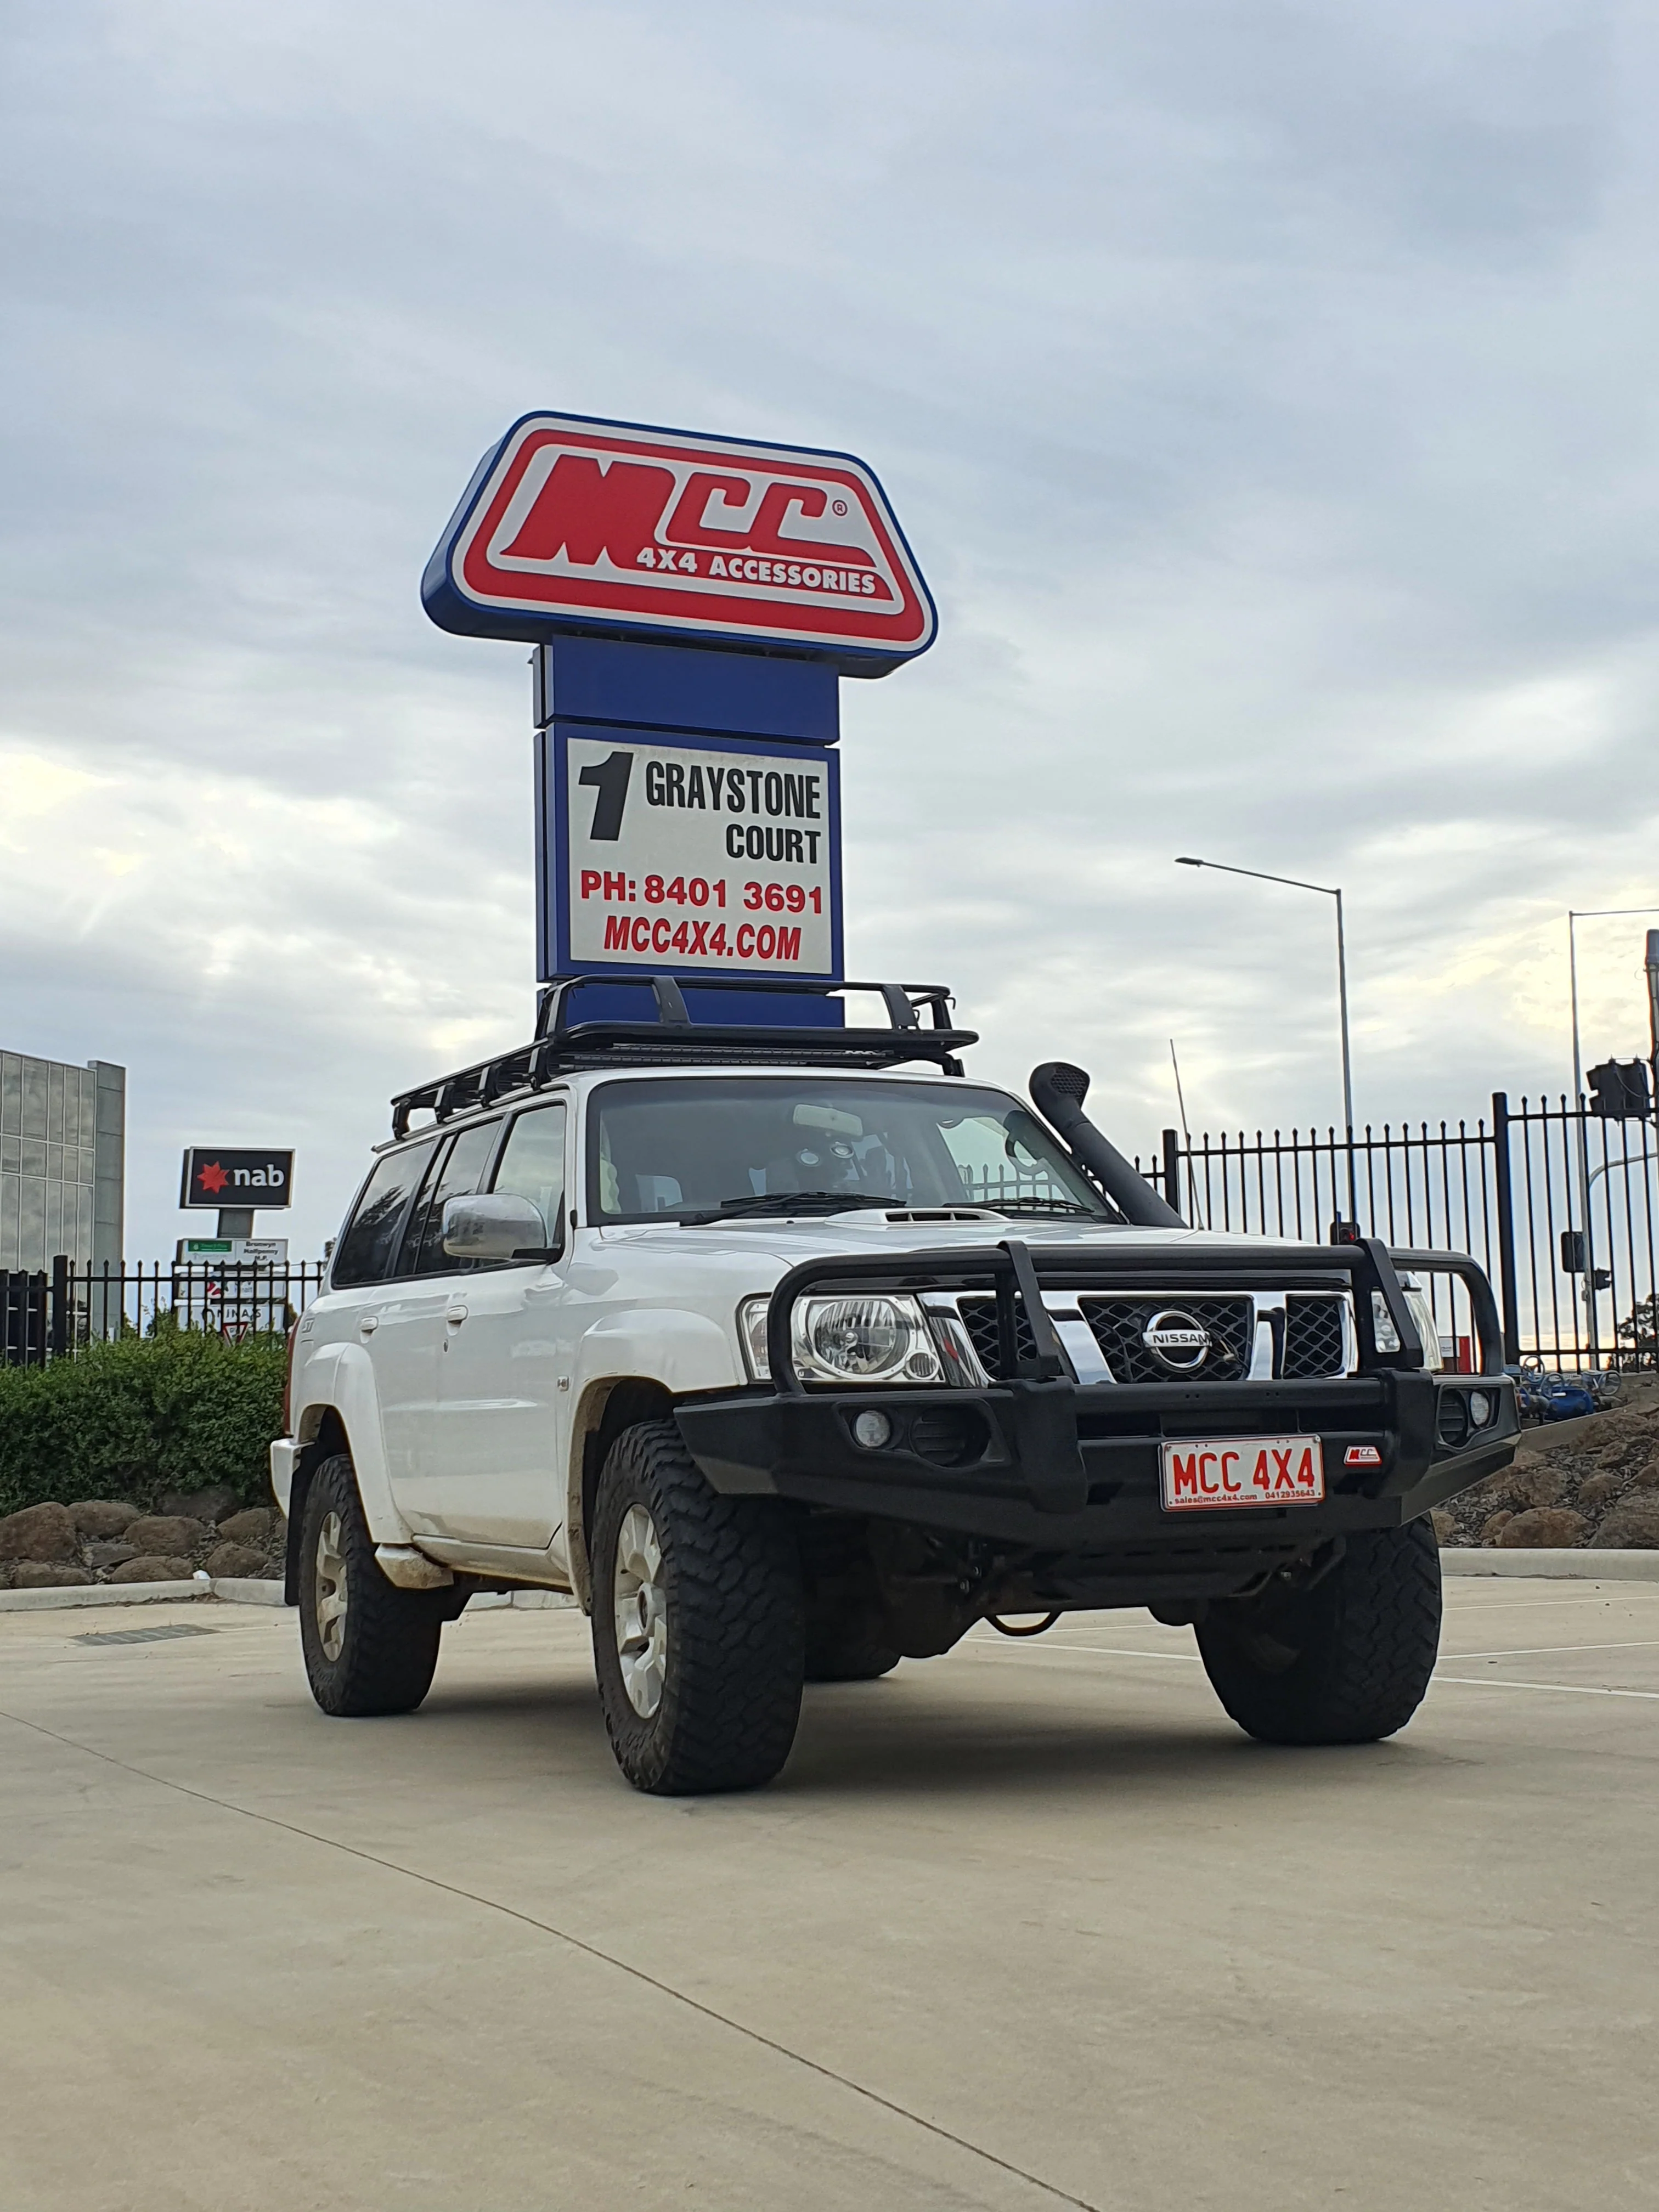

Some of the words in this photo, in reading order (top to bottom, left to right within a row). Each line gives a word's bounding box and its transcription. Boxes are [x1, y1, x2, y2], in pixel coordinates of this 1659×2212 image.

[499, 453, 878, 568] MCC
[636, 548, 698, 573] 4X4
[708, 559, 876, 595] ACCESSORIES
[578, 751, 634, 841] 1
[645, 760, 821, 820] GRAYSTONE
[726, 823, 821, 865] COURT
[580, 870, 636, 902] PH:
[644, 874, 726, 908] 8401
[743, 881, 822, 915] 3691
[603, 915, 802, 961] MCC4X4.COM
[233, 1164, 285, 1187] nab
[1153, 1333, 1210, 1346] NISSAN
[1172, 1451, 1242, 1496] MCC
[1252, 1447, 1315, 1491] 4X4
[1265, 1489, 1316, 1499] 0412935643
